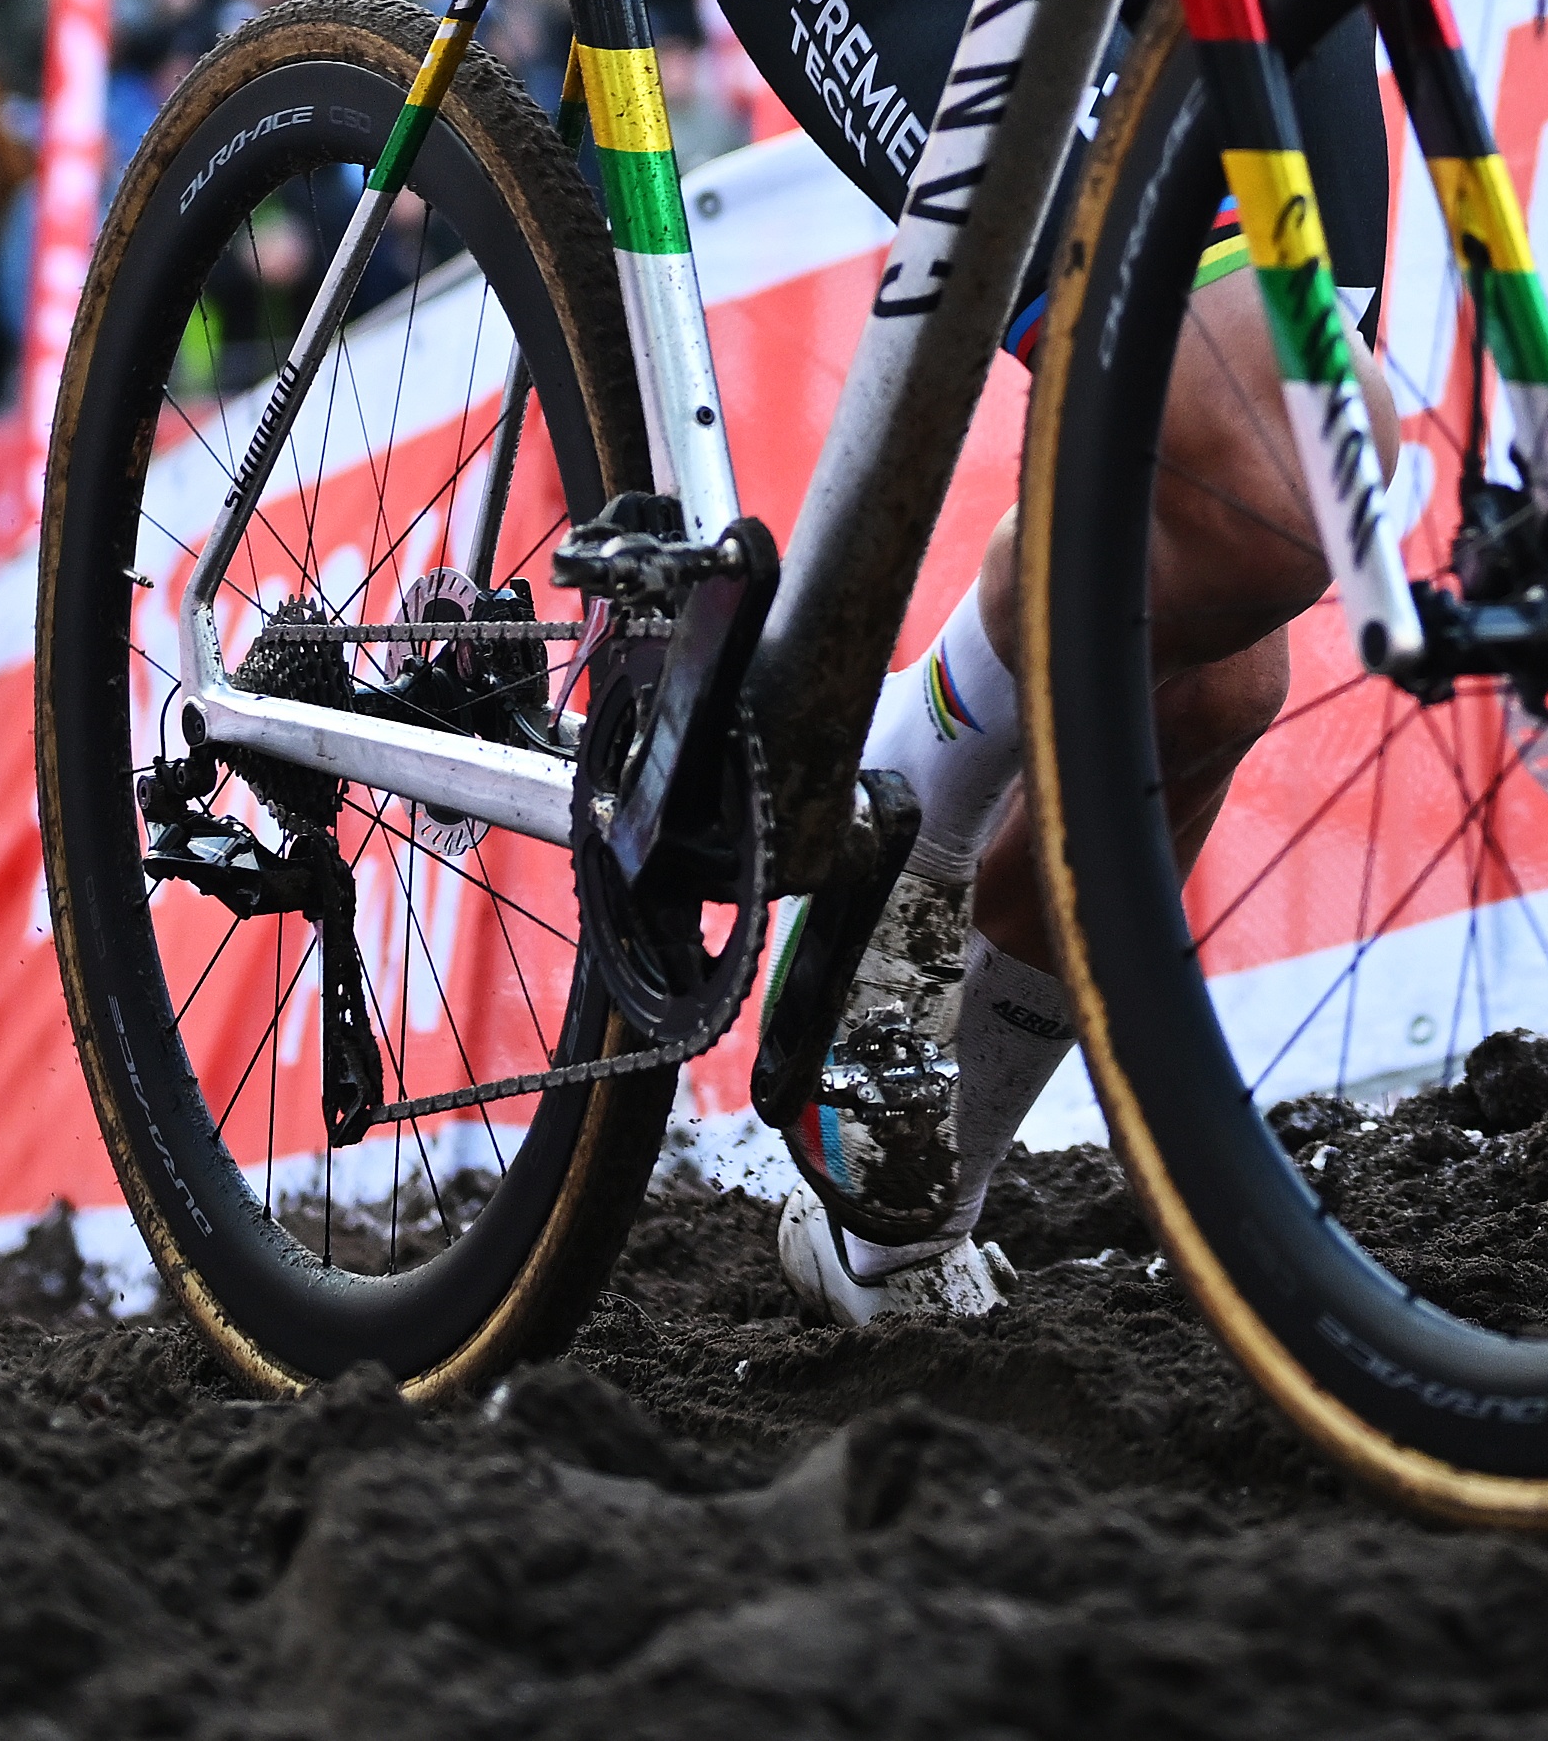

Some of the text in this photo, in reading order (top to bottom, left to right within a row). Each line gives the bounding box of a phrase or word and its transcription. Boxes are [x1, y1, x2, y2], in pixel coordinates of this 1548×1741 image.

[179, 105, 315, 216] DURA-ACE
[789, 6, 867, 168] TECH
[224, 359, 301, 516] SHIMANO
